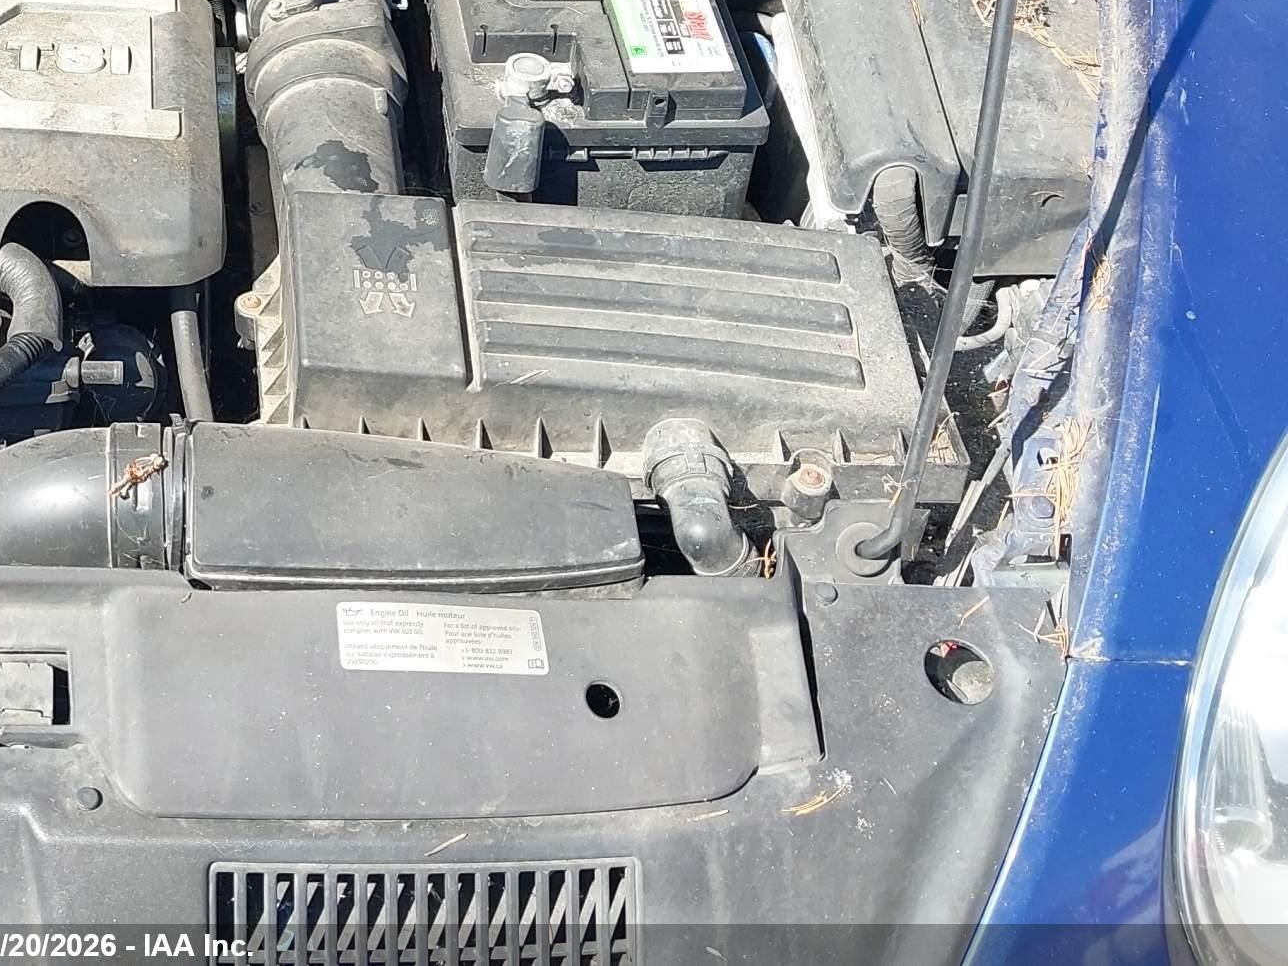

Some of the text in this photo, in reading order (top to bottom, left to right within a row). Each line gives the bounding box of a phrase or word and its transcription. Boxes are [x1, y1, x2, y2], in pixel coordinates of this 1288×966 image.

[0, 40, 132, 75] TSI
[370, 608, 409, 619] Engine Oil
[416, 610, 466, 620] Huile moteur
